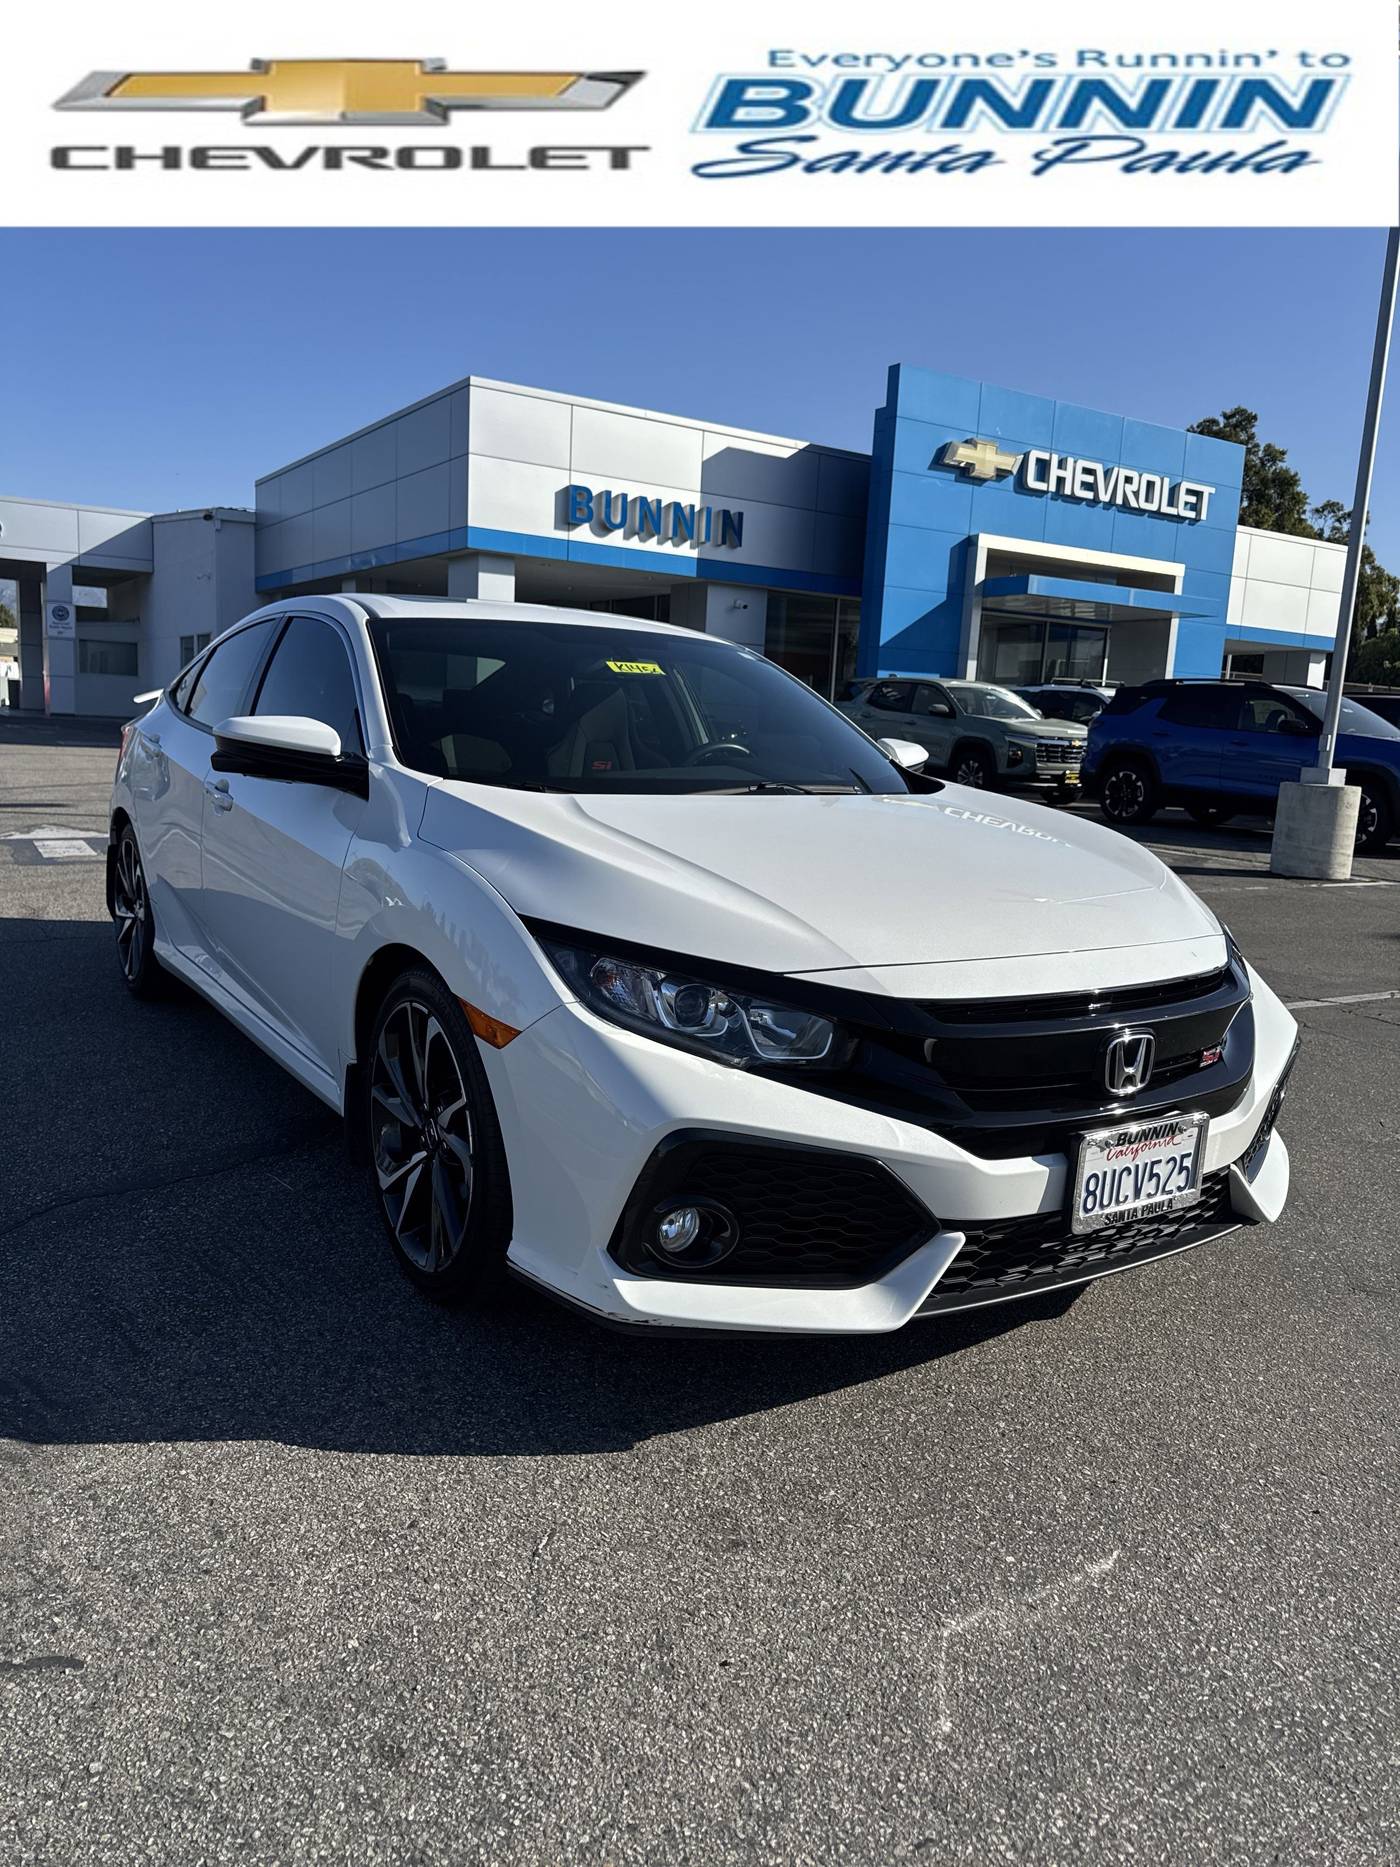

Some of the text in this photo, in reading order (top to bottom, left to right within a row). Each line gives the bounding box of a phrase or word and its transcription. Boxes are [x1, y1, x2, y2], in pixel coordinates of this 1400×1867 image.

[1026, 449, 1216, 521] CHEVROLET
[556, 484, 744, 549] BUNNIN
[1106, 1136, 1181, 1162] California
[1117, 1122, 1179, 1147] BUNNIN
[1083, 1152, 1192, 1214] 8UCV525
[1104, 1198, 1173, 1226] SANTA PAULA
